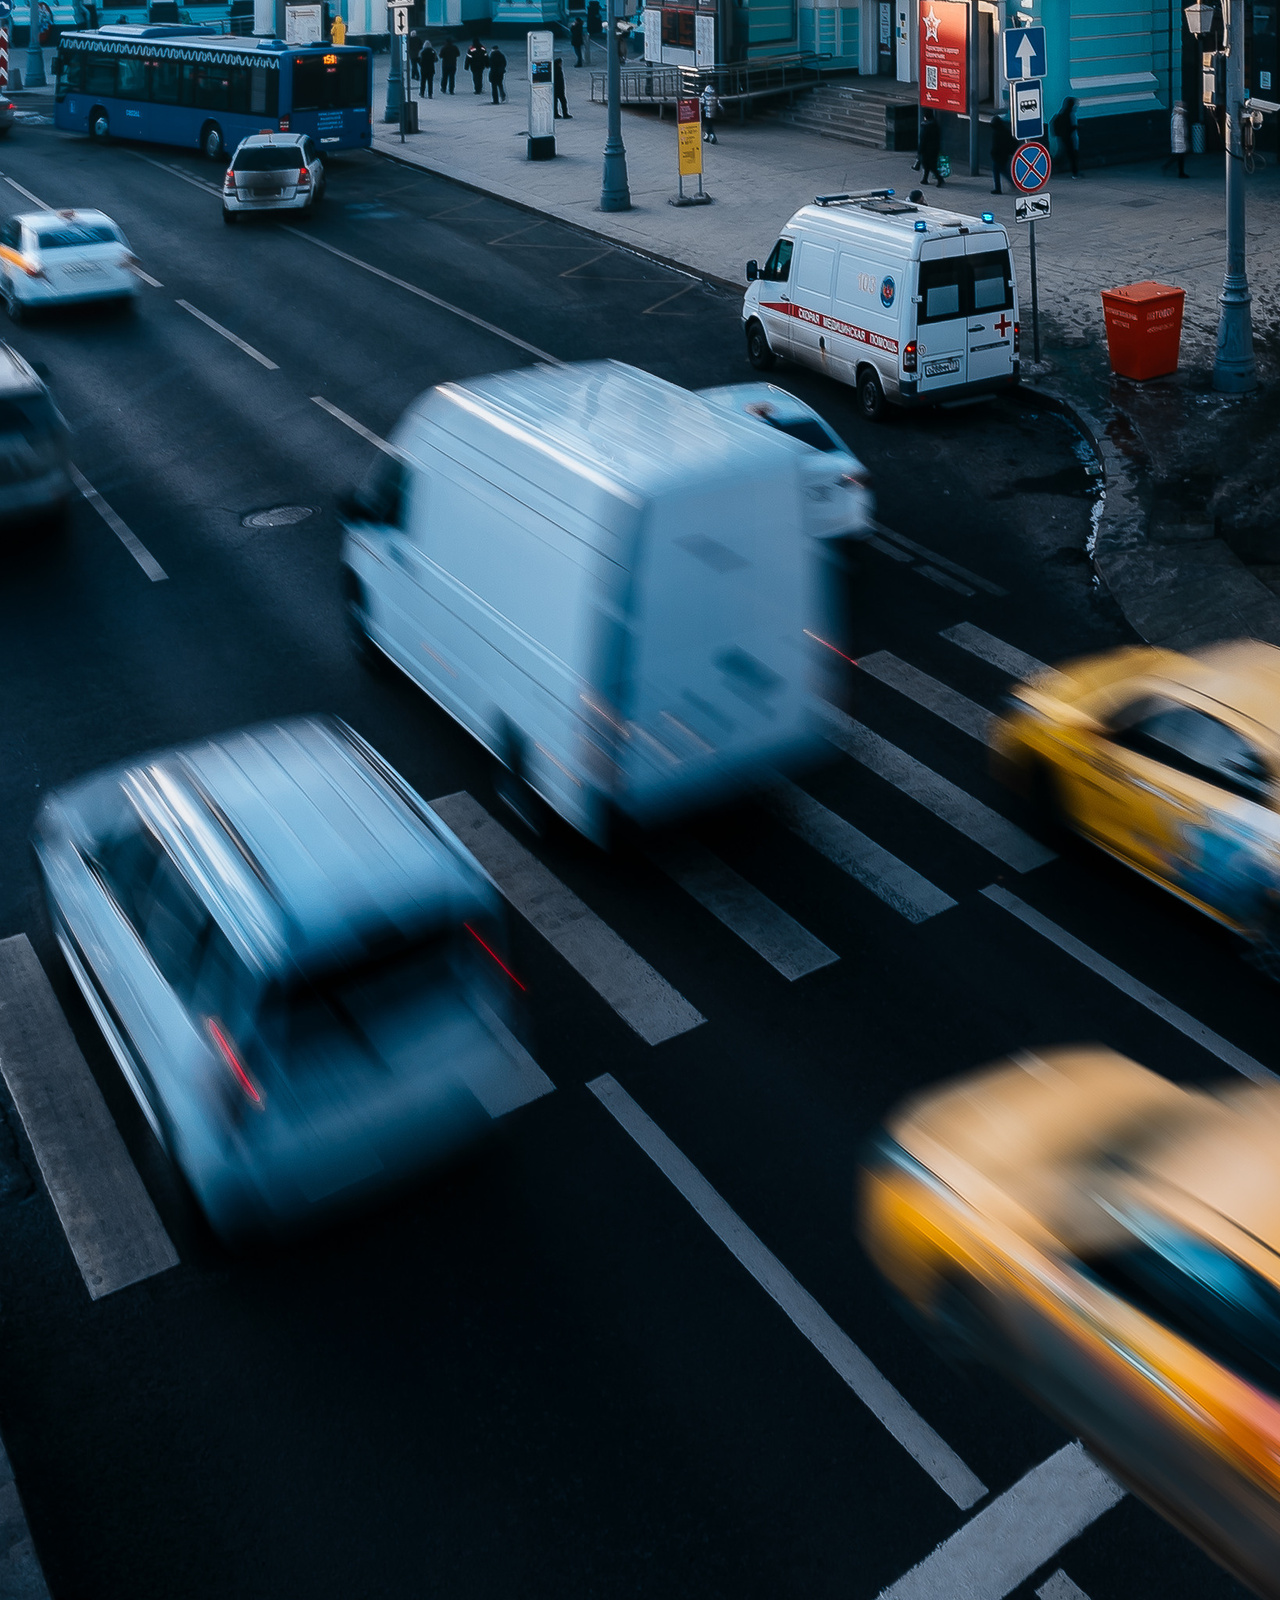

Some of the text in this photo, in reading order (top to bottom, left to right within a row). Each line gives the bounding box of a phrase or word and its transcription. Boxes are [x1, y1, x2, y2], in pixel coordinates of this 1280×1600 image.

[857, 272, 877, 294] 103
[798, 308, 898, 353] СКОРАЯ МЕДИЦИНСКАЯ ПОМОЩЬ
